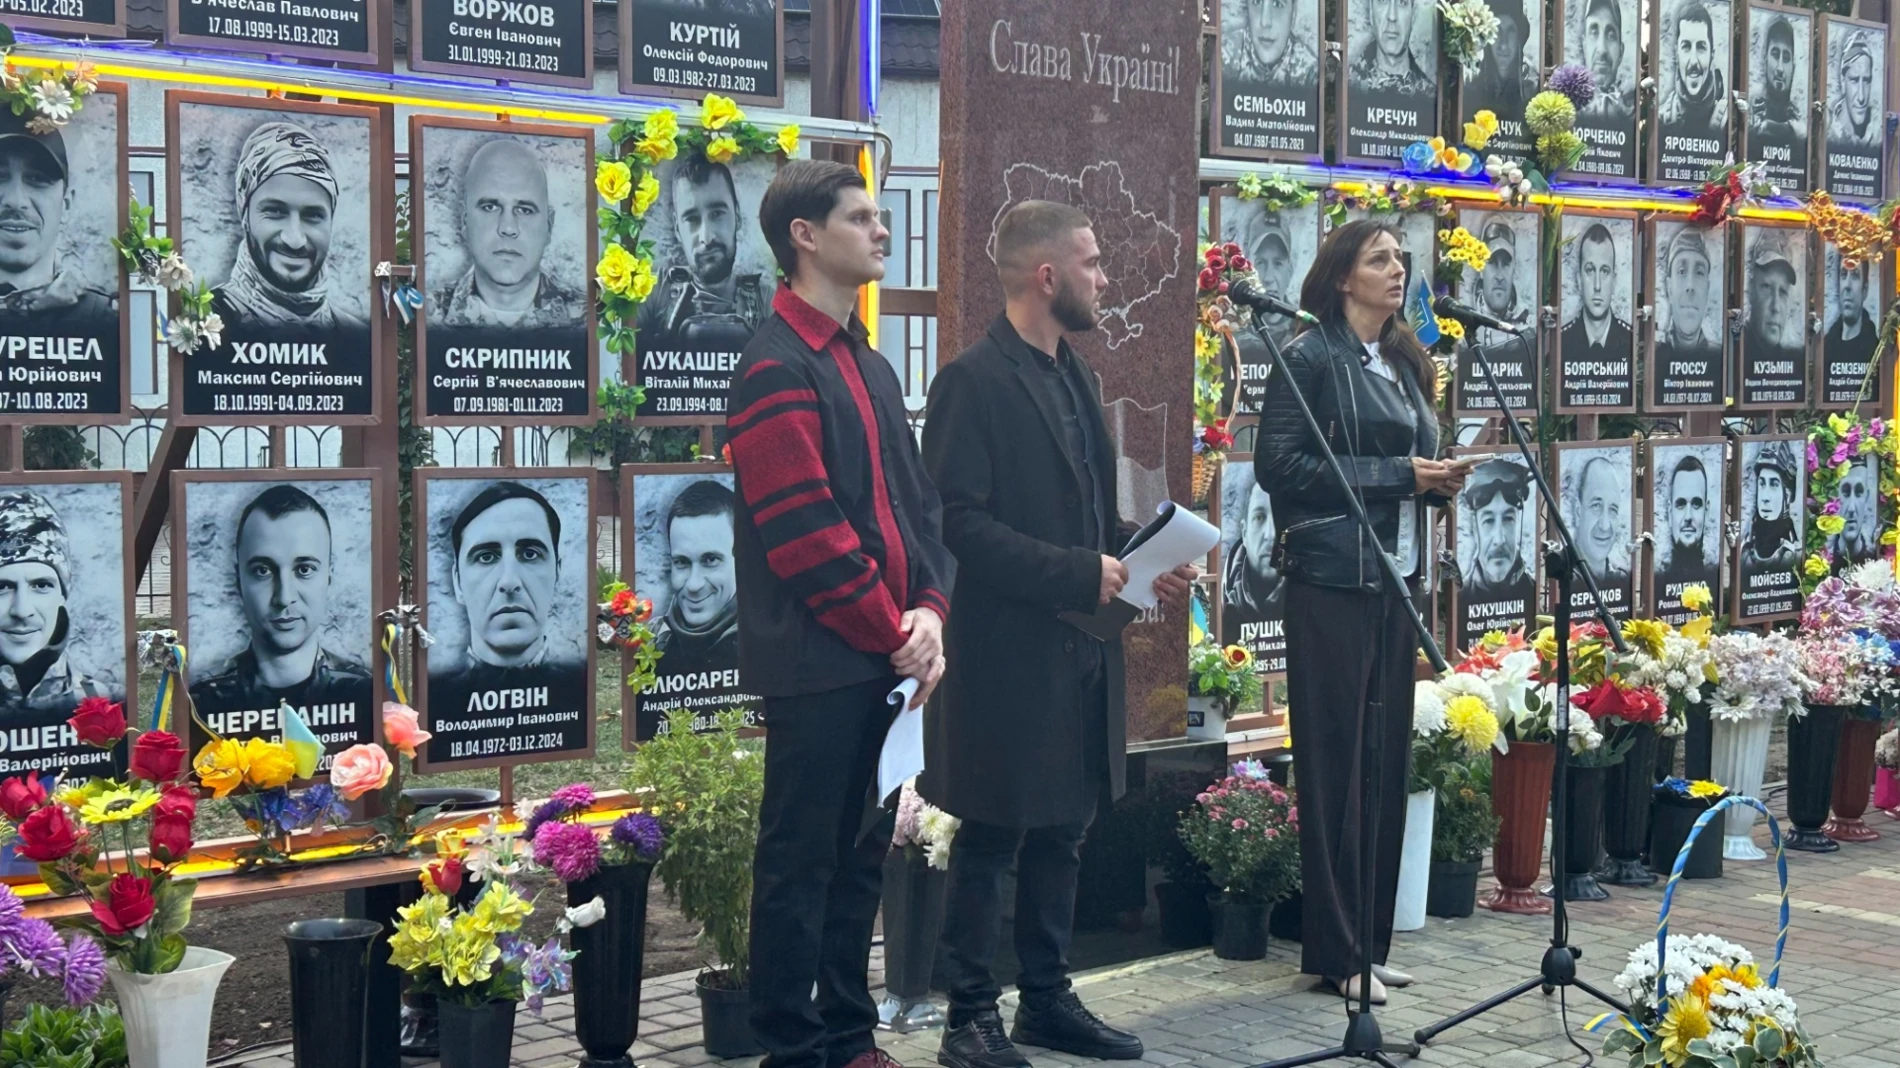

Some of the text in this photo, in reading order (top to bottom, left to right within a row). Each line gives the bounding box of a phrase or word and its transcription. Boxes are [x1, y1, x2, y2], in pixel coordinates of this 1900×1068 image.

[0, 0, 83, 17] -05.02.2023
[191, 0, 359, 22] ячеслав Павлович
[453, 0, 555, 27] ВОРЖОВ
[208, 17, 339, 46] 17.08.1999-15.03.2023
[449, 22, 561, 48] Євген Іванович
[670, 21, 740, 49] КУРТІЙ
[448, 44, 559, 72] 31.01.1999-21.03.2023
[643, 44, 768, 70] Олексій Федорович
[988, 19, 1180, 103] Слава Україні!
[653, 67, 756, 92] 09.03.1982-27.03.2023
[1233, 94, 1306, 117] СЕМЬОХІН
[1225, 114, 1315, 132] Вадим Анатолійович
[1367, 107, 1417, 127] КРЕЧУН
[1350, 127, 1387, 140] Олександр
[1573, 127, 1626, 146] ЮРЧЕНКО
[1664, 136, 1720, 153] ЯРОВЕНКО
[1762, 144, 1791, 162] КІРОЙ
[1661, 153, 1686, 165] Дмитро
[1829, 153, 1879, 171] КОВАЛЕНКО
[231, 342, 328, 365] ХОМИК
[445, 347, 572, 370] СКРИПНИК
[642, 351, 743, 371] ЛУКАШЕН
[8, 366, 102, 385] Юрійович
[1230, 364, 1272, 380] ЕПО
[1564, 357, 1628, 376] БОЯРСЬКИЙ
[1670, 361, 1707, 375] ГРОССУ
[1753, 361, 1794, 374] КУЗЬМІН
[198, 370, 363, 388] Максим Сергійович
[433, 375, 586, 390] Сергій В'ячеславович
[645, 376, 690, 389] Віталій
[1463, 381, 1532, 392] Андрій сильович
[1564, 379, 1629, 390] Андрій Валерійович
[0, 392, 88, 409] 7-10.08.2023
[213, 394, 343, 411] 18.10.1991-04.09.2023
[453, 397, 563, 412] 07.09.1981-01.11.2023
[656, 397, 728, 411] 23.09.1994-08.1
[1750, 571, 1791, 588] МОЙСЕЄВ
[1570, 588, 1621, 606] СЕРКОВ
[1468, 599, 1525, 618] КУКУШКІН
[1240, 620, 1285, 641] ПУШК
[1467, 621, 1485, 631] Олег
[1258, 638, 1286, 651] Михай
[467, 686, 548, 712] ЛОГВІН
[642, 693, 763, 712] Андрій Олександро
[207, 702, 356, 734] ЧЕРЕАНІН
[436, 711, 579, 732] Володимир Іванович
[0, 724, 88, 753] ШЕН
[450, 733, 564, 757] 18.04.1972-03.12.2024
[0, 752, 111, 773] Валерійович
